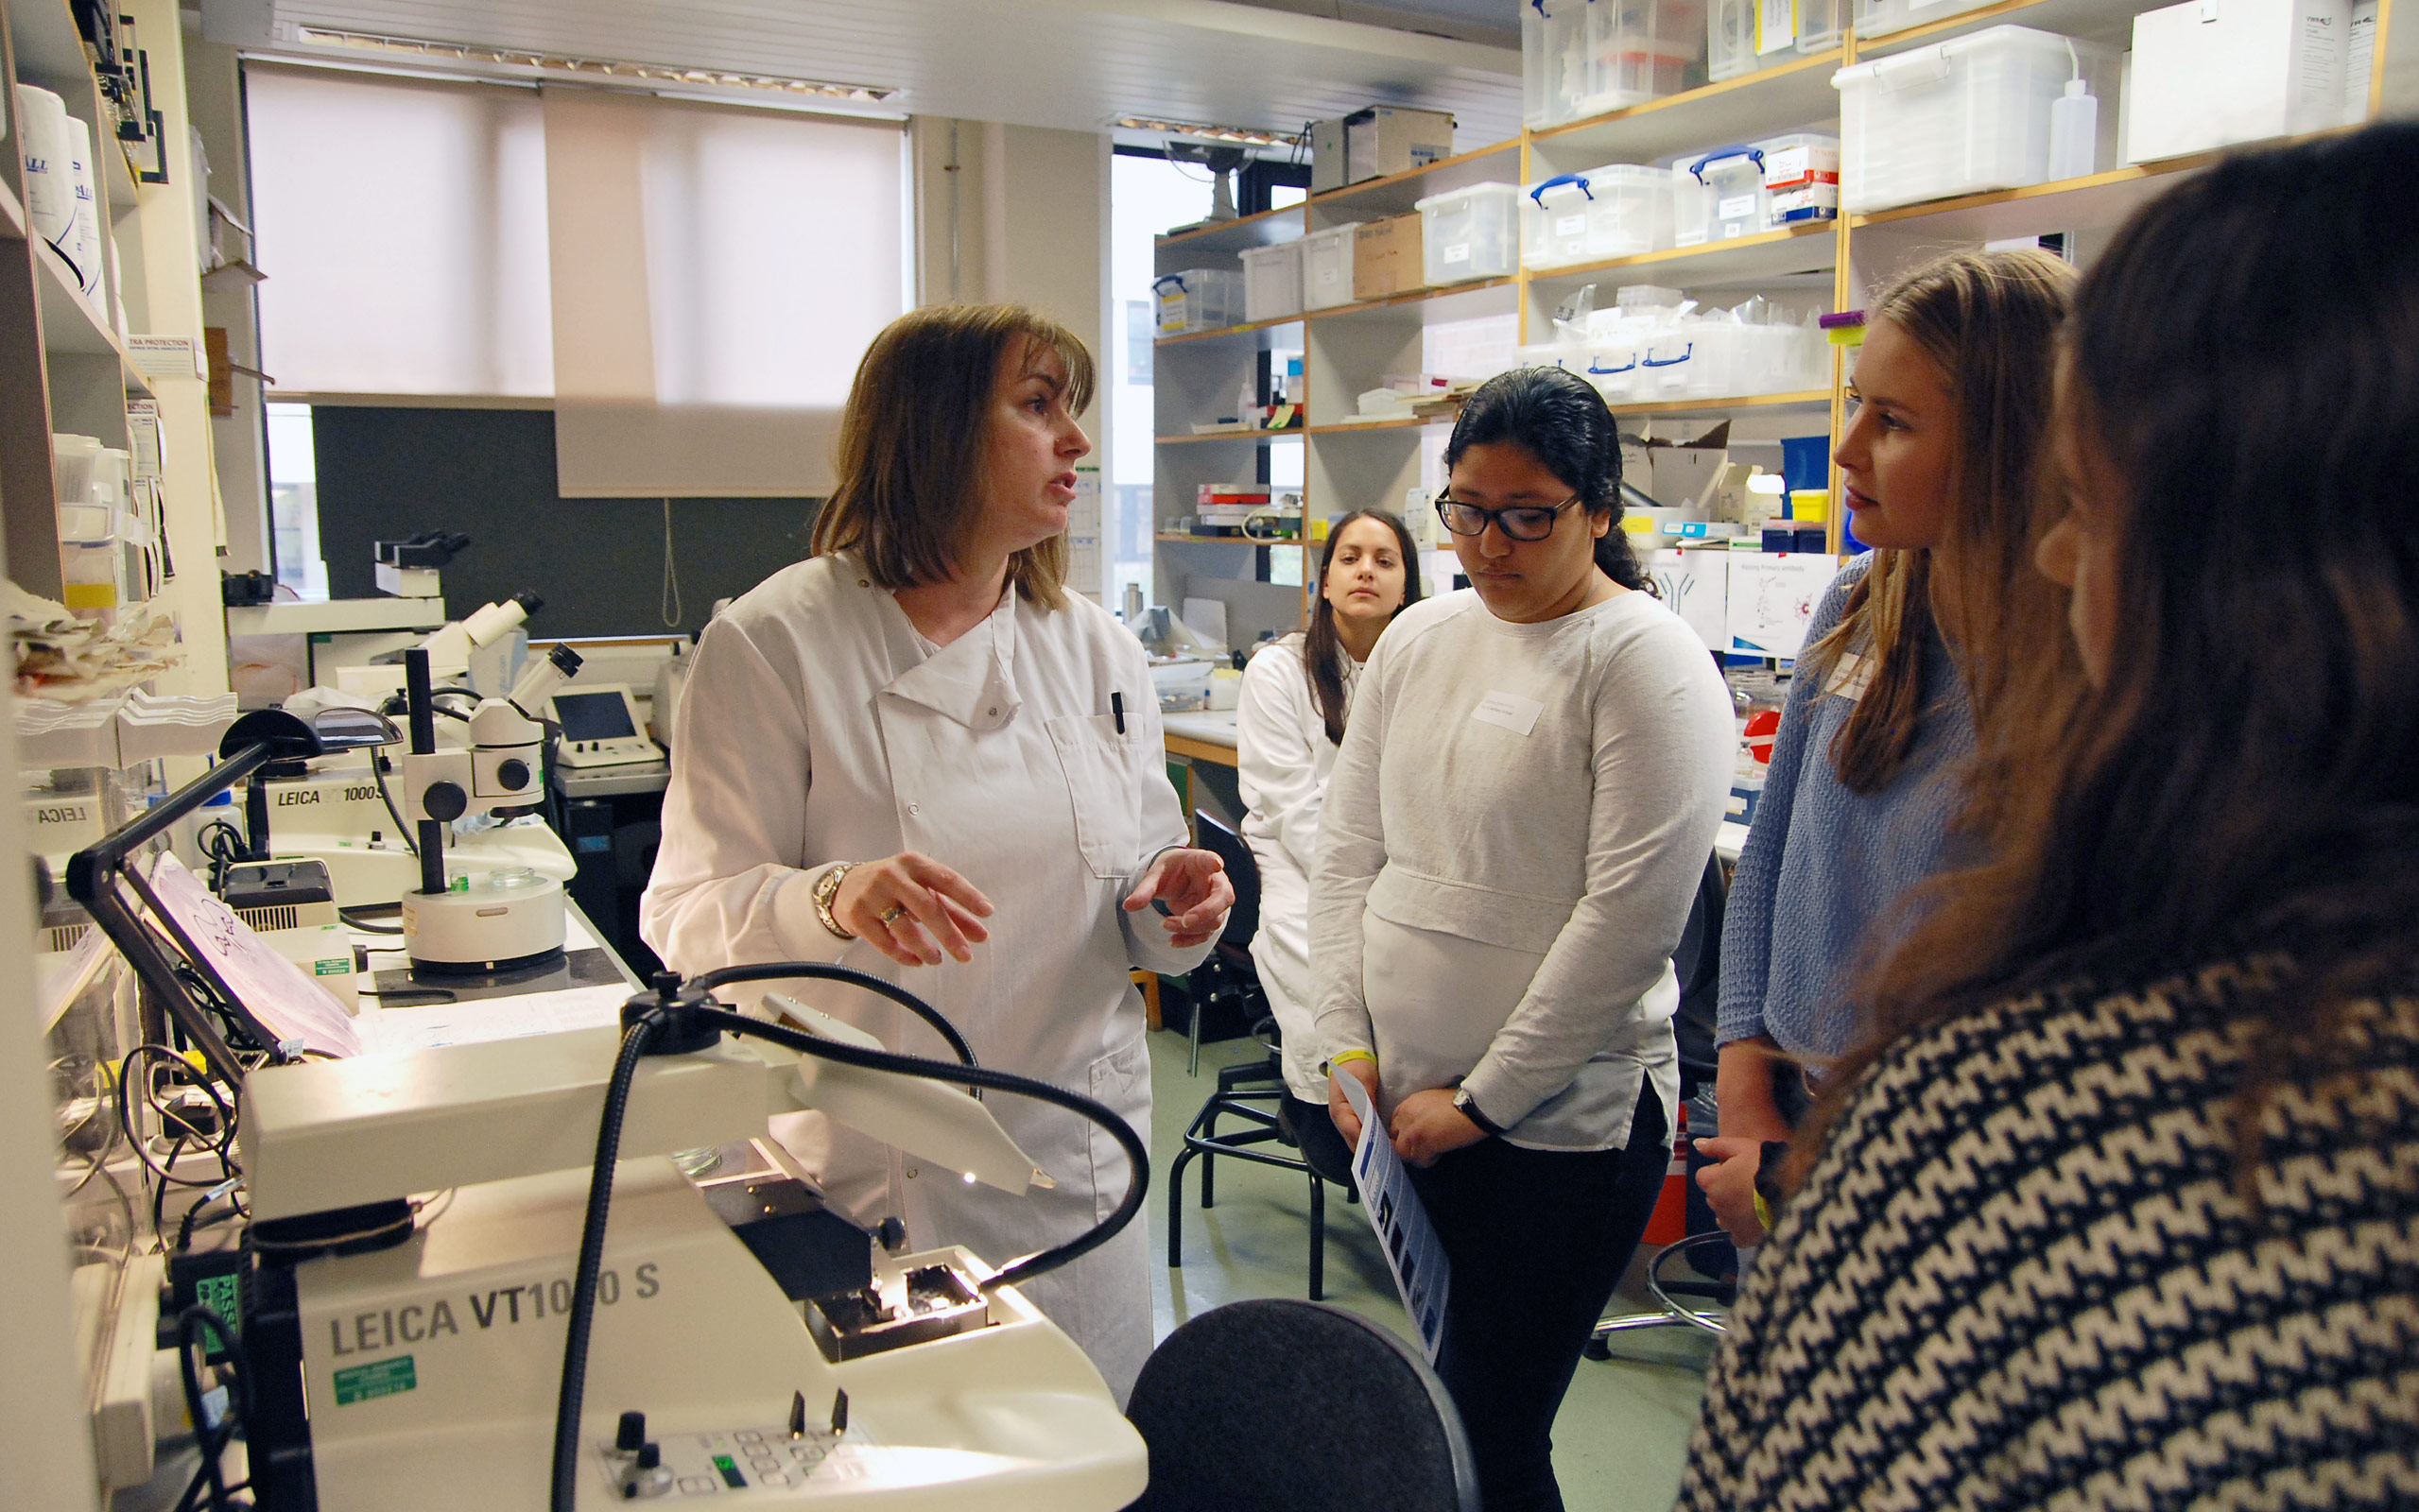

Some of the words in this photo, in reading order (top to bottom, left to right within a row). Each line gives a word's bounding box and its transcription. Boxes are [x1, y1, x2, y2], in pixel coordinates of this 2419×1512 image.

[278, 790, 320, 807] LEICA
[331, 1299, 458, 1356] LEICA
[469, 1270, 621, 1330] VT100
[635, 1263, 660, 1299] S
